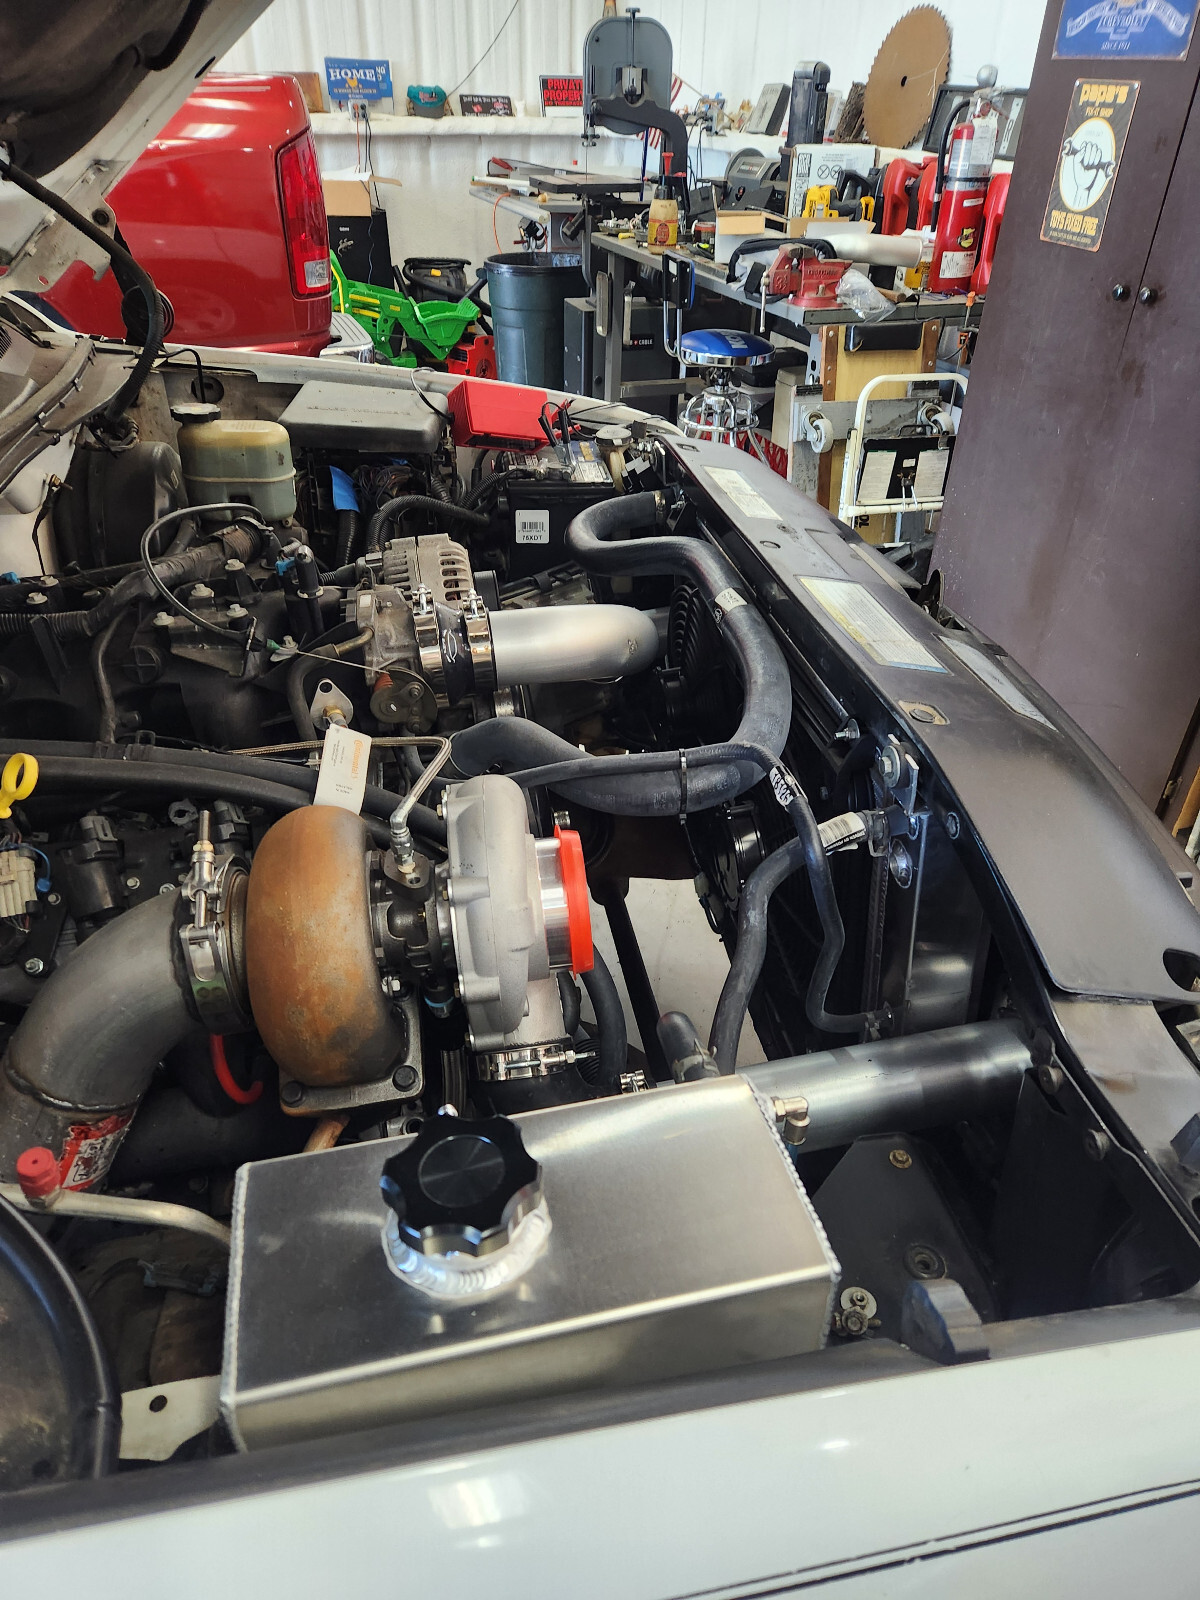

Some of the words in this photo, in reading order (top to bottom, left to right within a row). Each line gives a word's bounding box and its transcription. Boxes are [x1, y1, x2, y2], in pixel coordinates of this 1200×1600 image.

[1101, 13, 1146, 28] CHEVROLET
[329, 68, 376, 82] HOME
[543, 89, 583, 101] PROPERT
[1050, 209, 1067, 229] TOYS
[1064, 212, 1083, 234] FIXED
[1081, 216, 1099, 237] FREE
[351, 739, 364, 775] Continental
